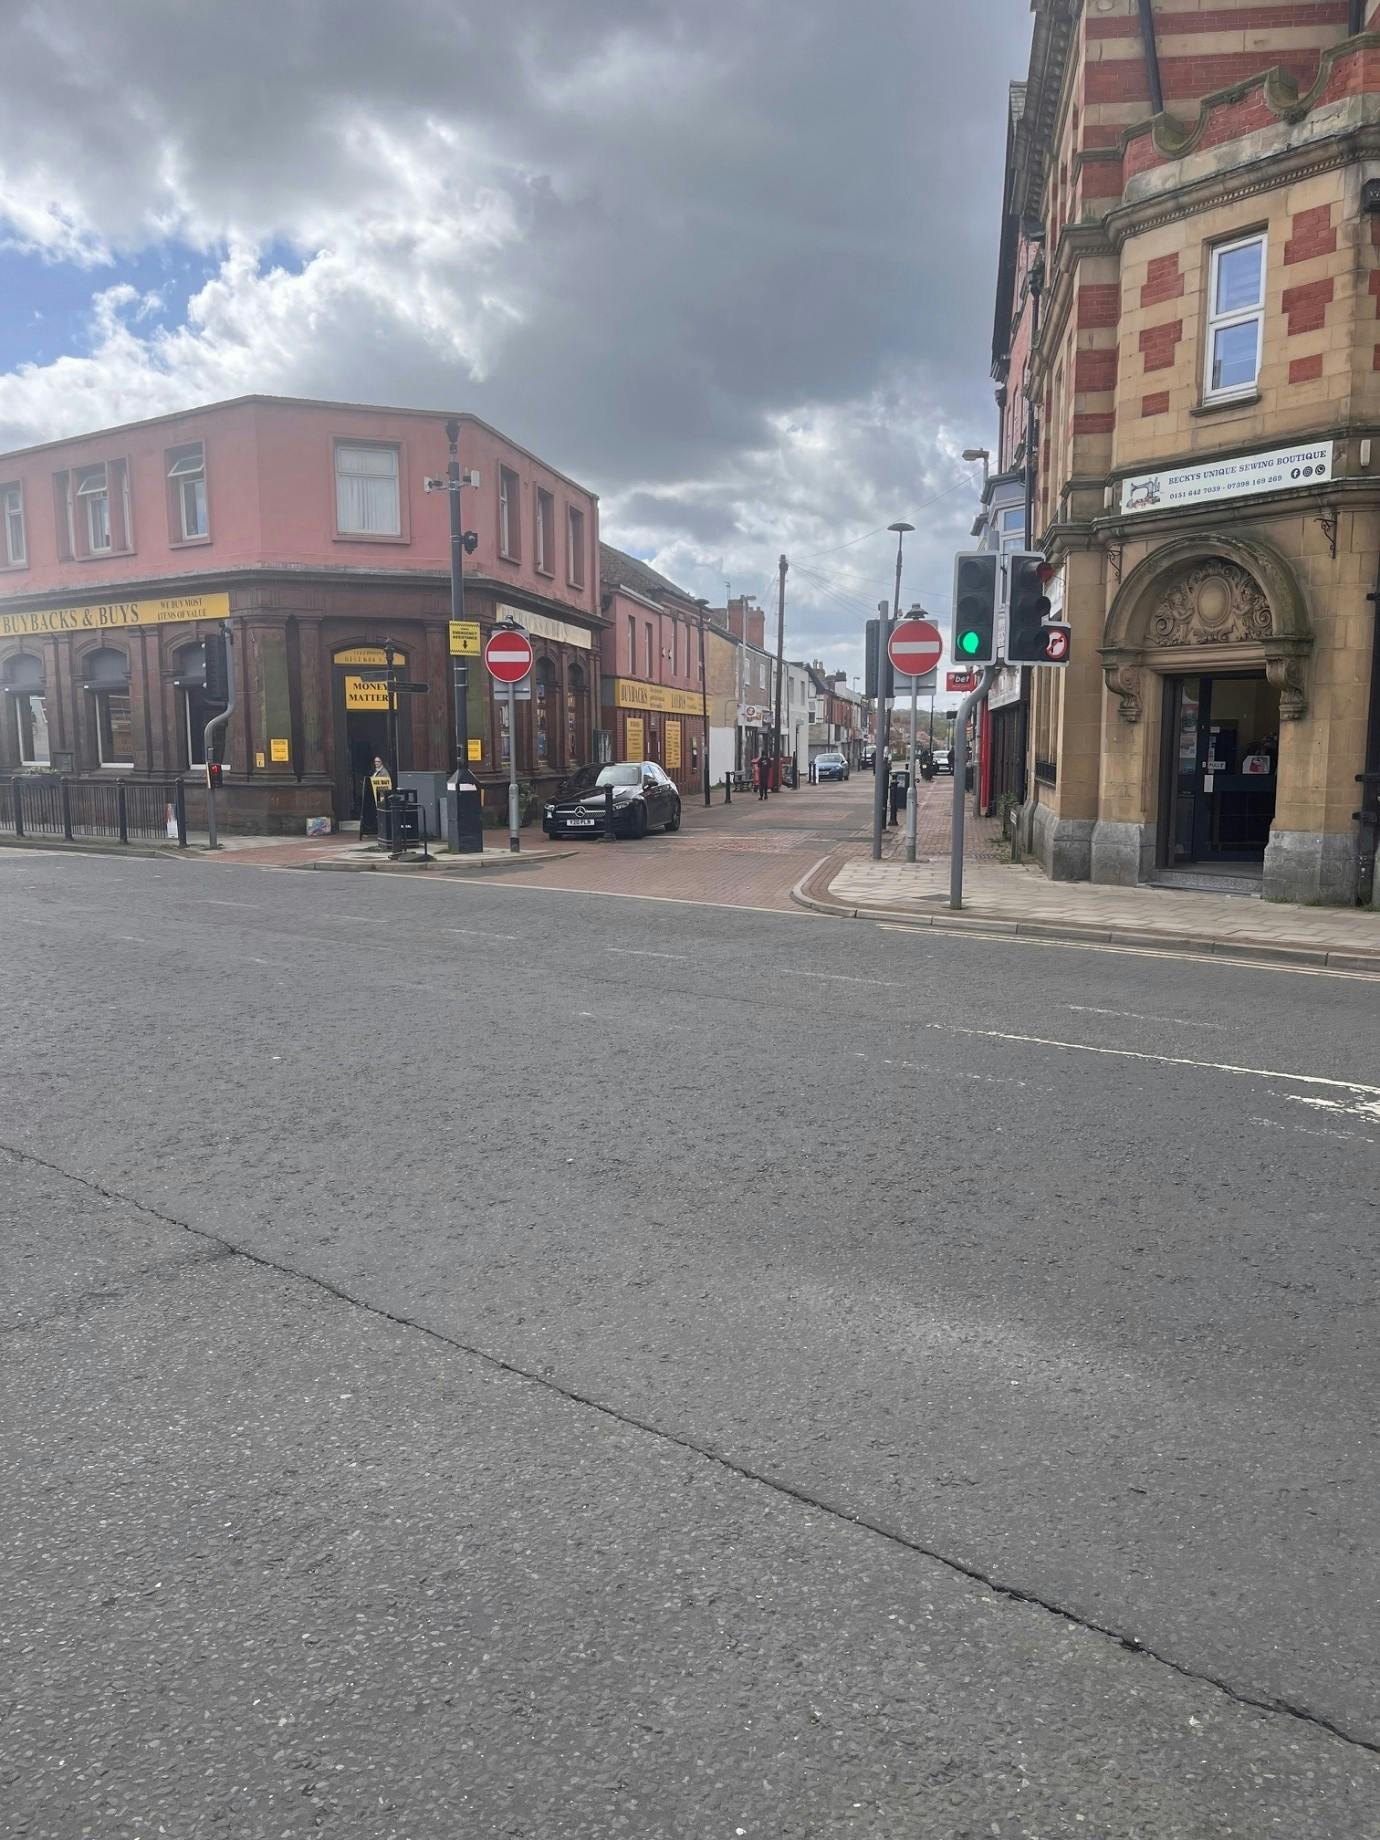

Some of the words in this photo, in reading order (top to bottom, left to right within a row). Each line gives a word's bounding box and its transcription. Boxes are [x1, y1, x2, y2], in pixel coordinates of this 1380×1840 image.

[1168, 472, 1201, 485] BECKYS
[1203, 466, 1237, 479] UNIQUE
[1239, 459, 1274, 473] SEWING
[1276, 450, 1326, 465] BOUTIQUE
[171, 599, 183, 608] BUY
[184, 598, 202, 607] MOST
[3, 609, 78, 634] BUYBACKS
[82, 610, 94, 627] &
[99, 603, 139, 625] BUYS
[157, 610, 176, 621] ITEMS
[177, 610, 185, 619] OF
[186, 608, 207, 617] VALUE
[353, 682, 388, 690] MONEY
[349, 694, 389, 702] MATTER
